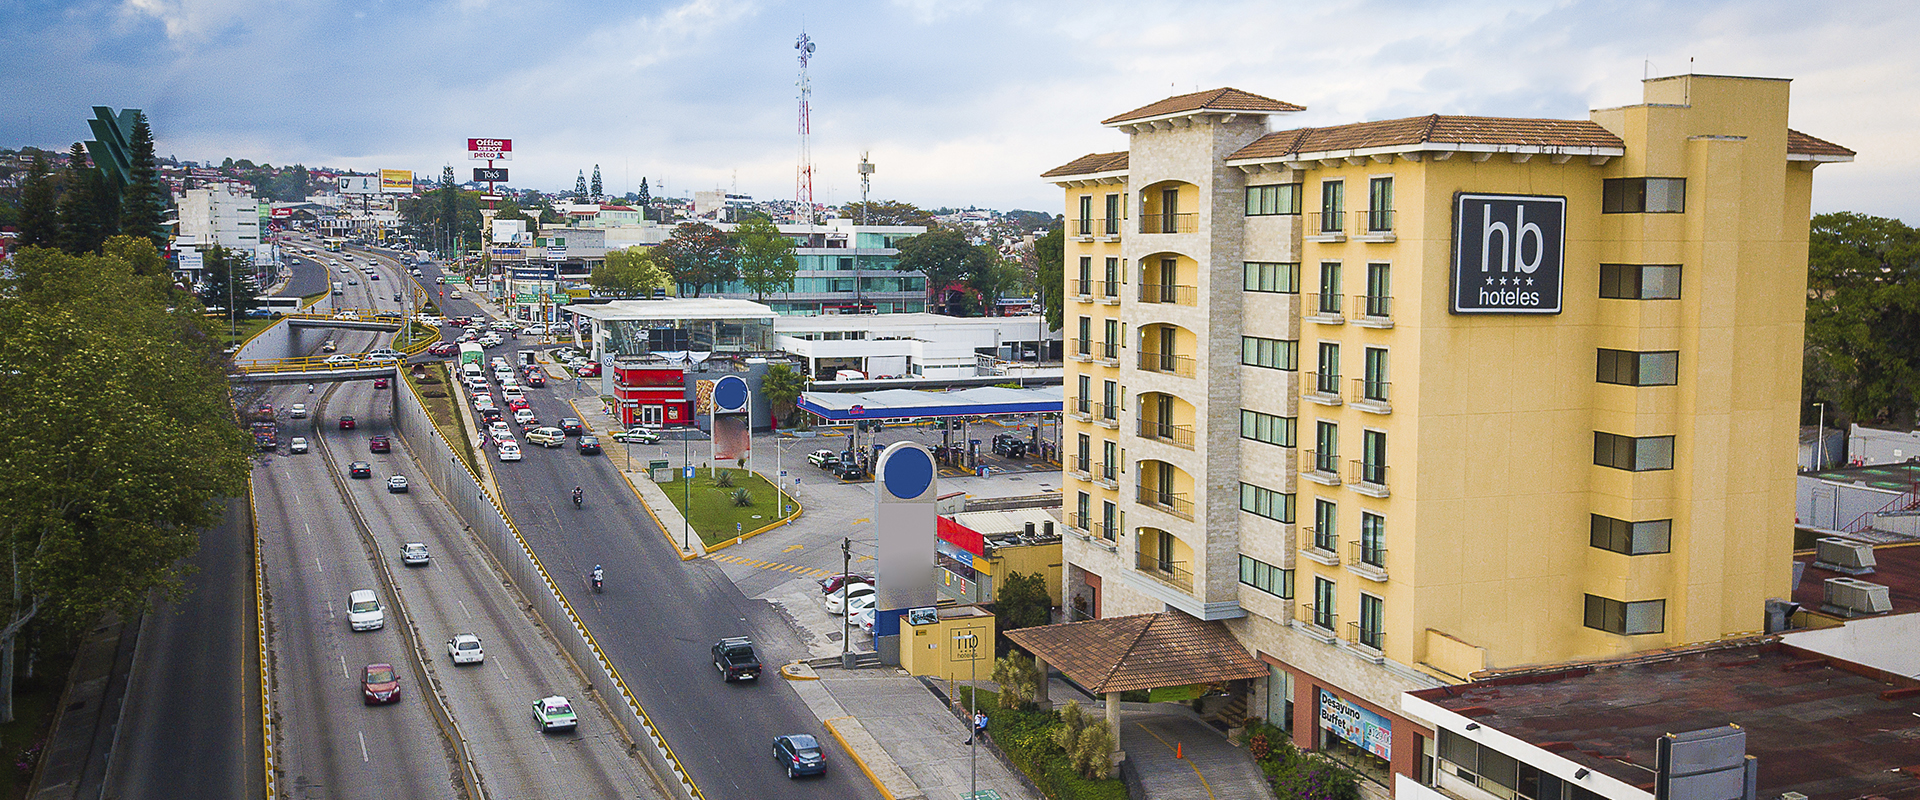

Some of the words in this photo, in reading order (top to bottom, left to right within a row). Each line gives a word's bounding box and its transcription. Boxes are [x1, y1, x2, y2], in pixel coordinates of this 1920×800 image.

[1481, 203, 1544, 274] hb
[1478, 286, 1540, 306] hoteles
[1321, 693, 1361, 721] Desayuno
[1321, 709, 1347, 730] Buffet
